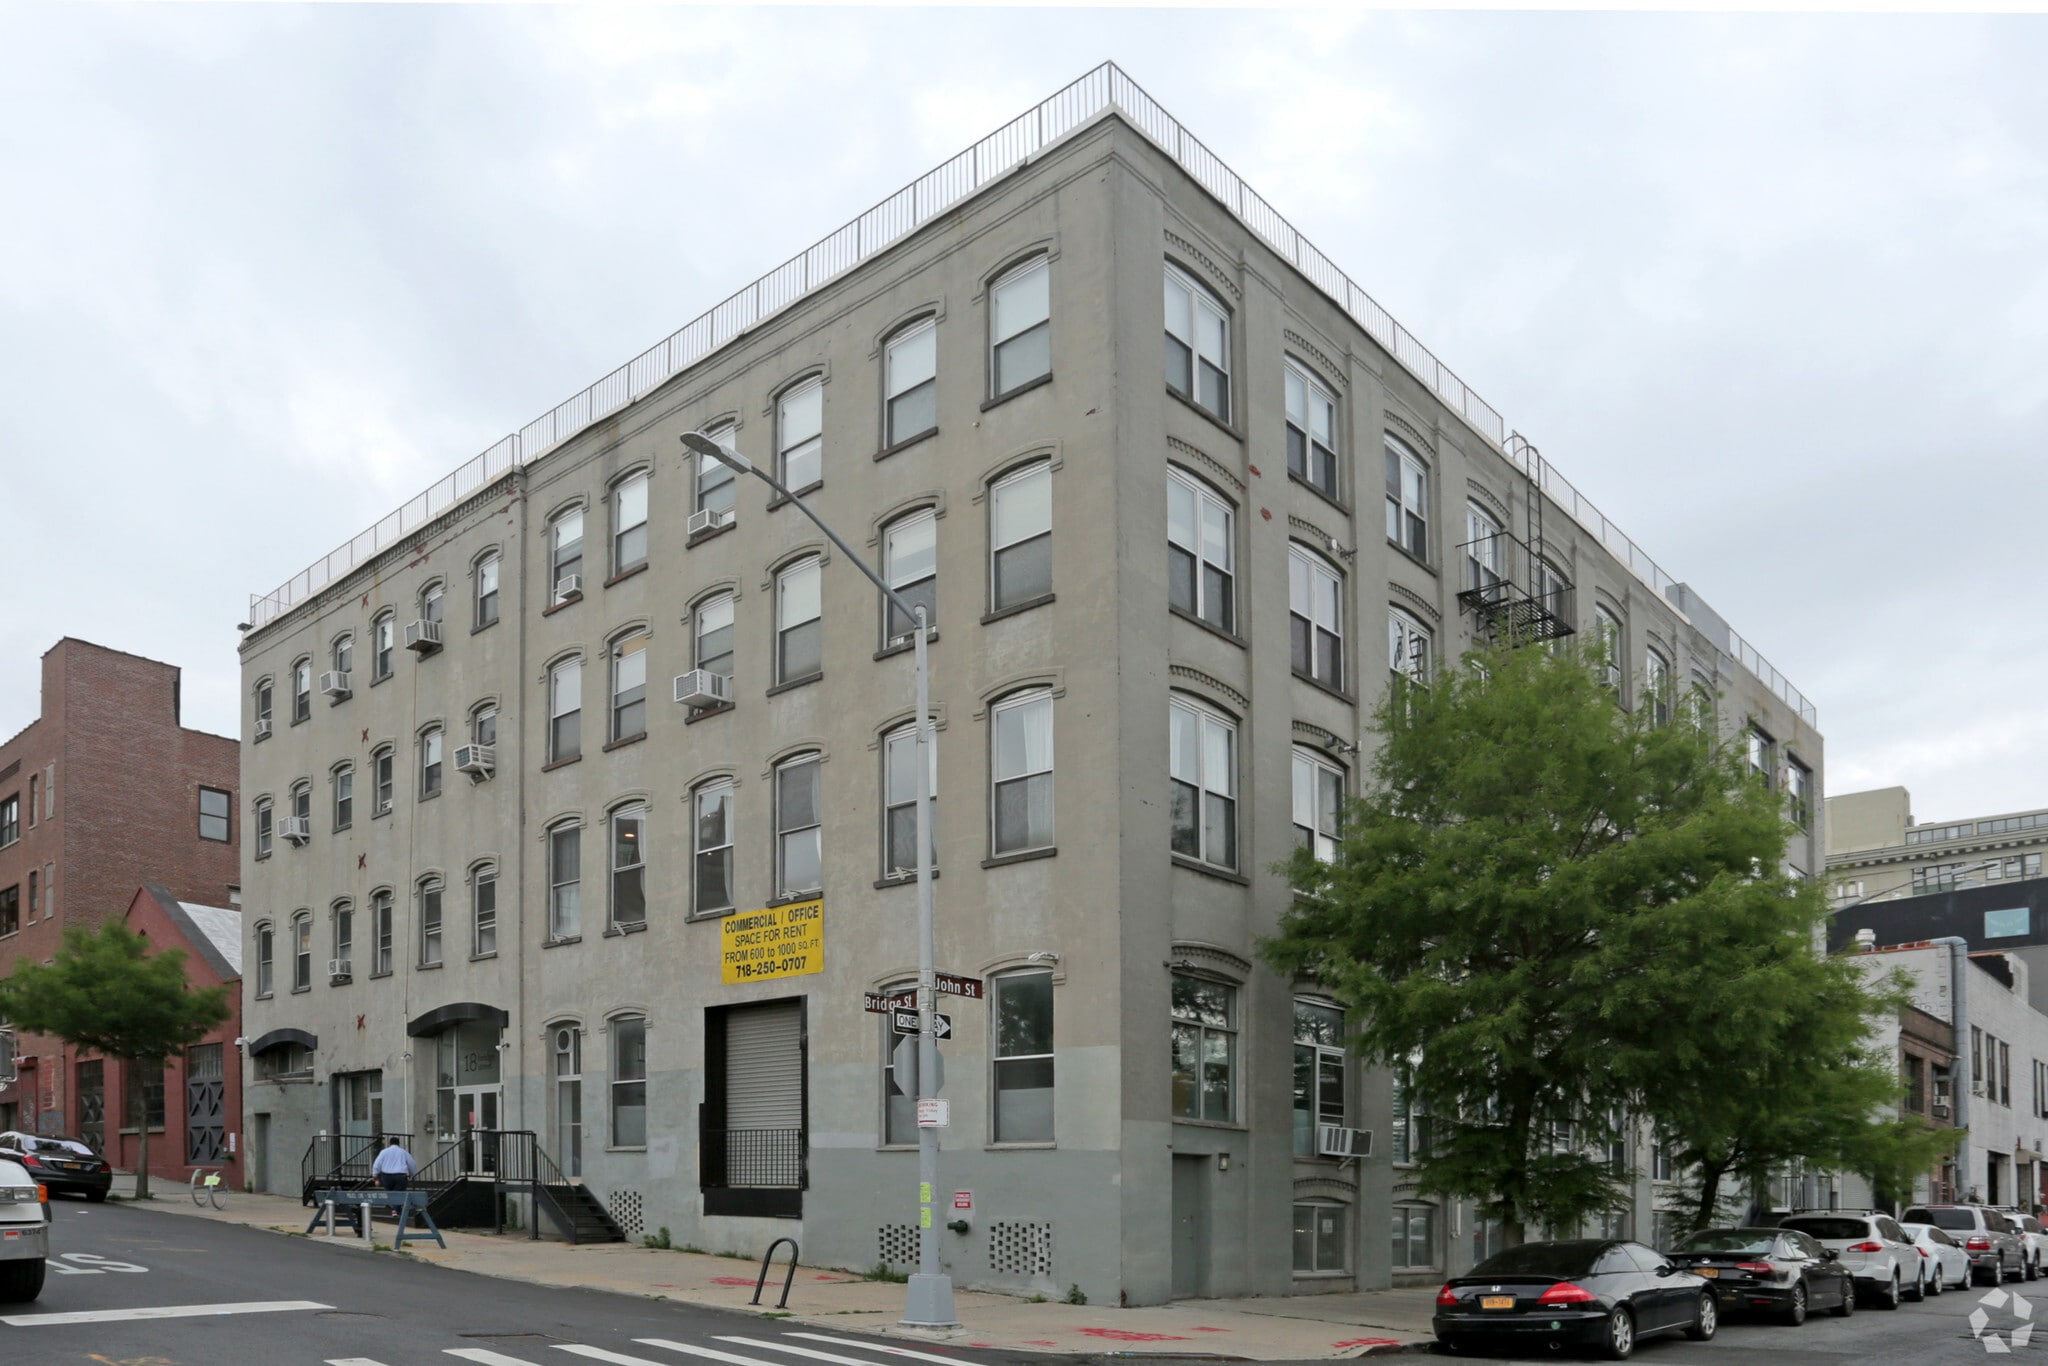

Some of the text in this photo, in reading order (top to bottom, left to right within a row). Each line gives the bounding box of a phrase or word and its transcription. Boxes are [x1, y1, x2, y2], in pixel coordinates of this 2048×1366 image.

[725, 913, 777, 933] COMMERCIAL
[788, 905, 819, 923] OFFICE
[735, 924, 807, 947] SPACE FOR RENT
[725, 949, 748, 964] FROM
[750, 947, 764, 960] 600
[767, 948, 775, 958] to
[778, 942, 796, 956] 1000
[736, 956, 807, 978] 718-250-0707
[935, 978, 975, 996] John St
[865, 995, 912, 1014] Bridge St
[899, 1015, 917, 1027] ONE
[464, 1053, 477, 1071] 18
